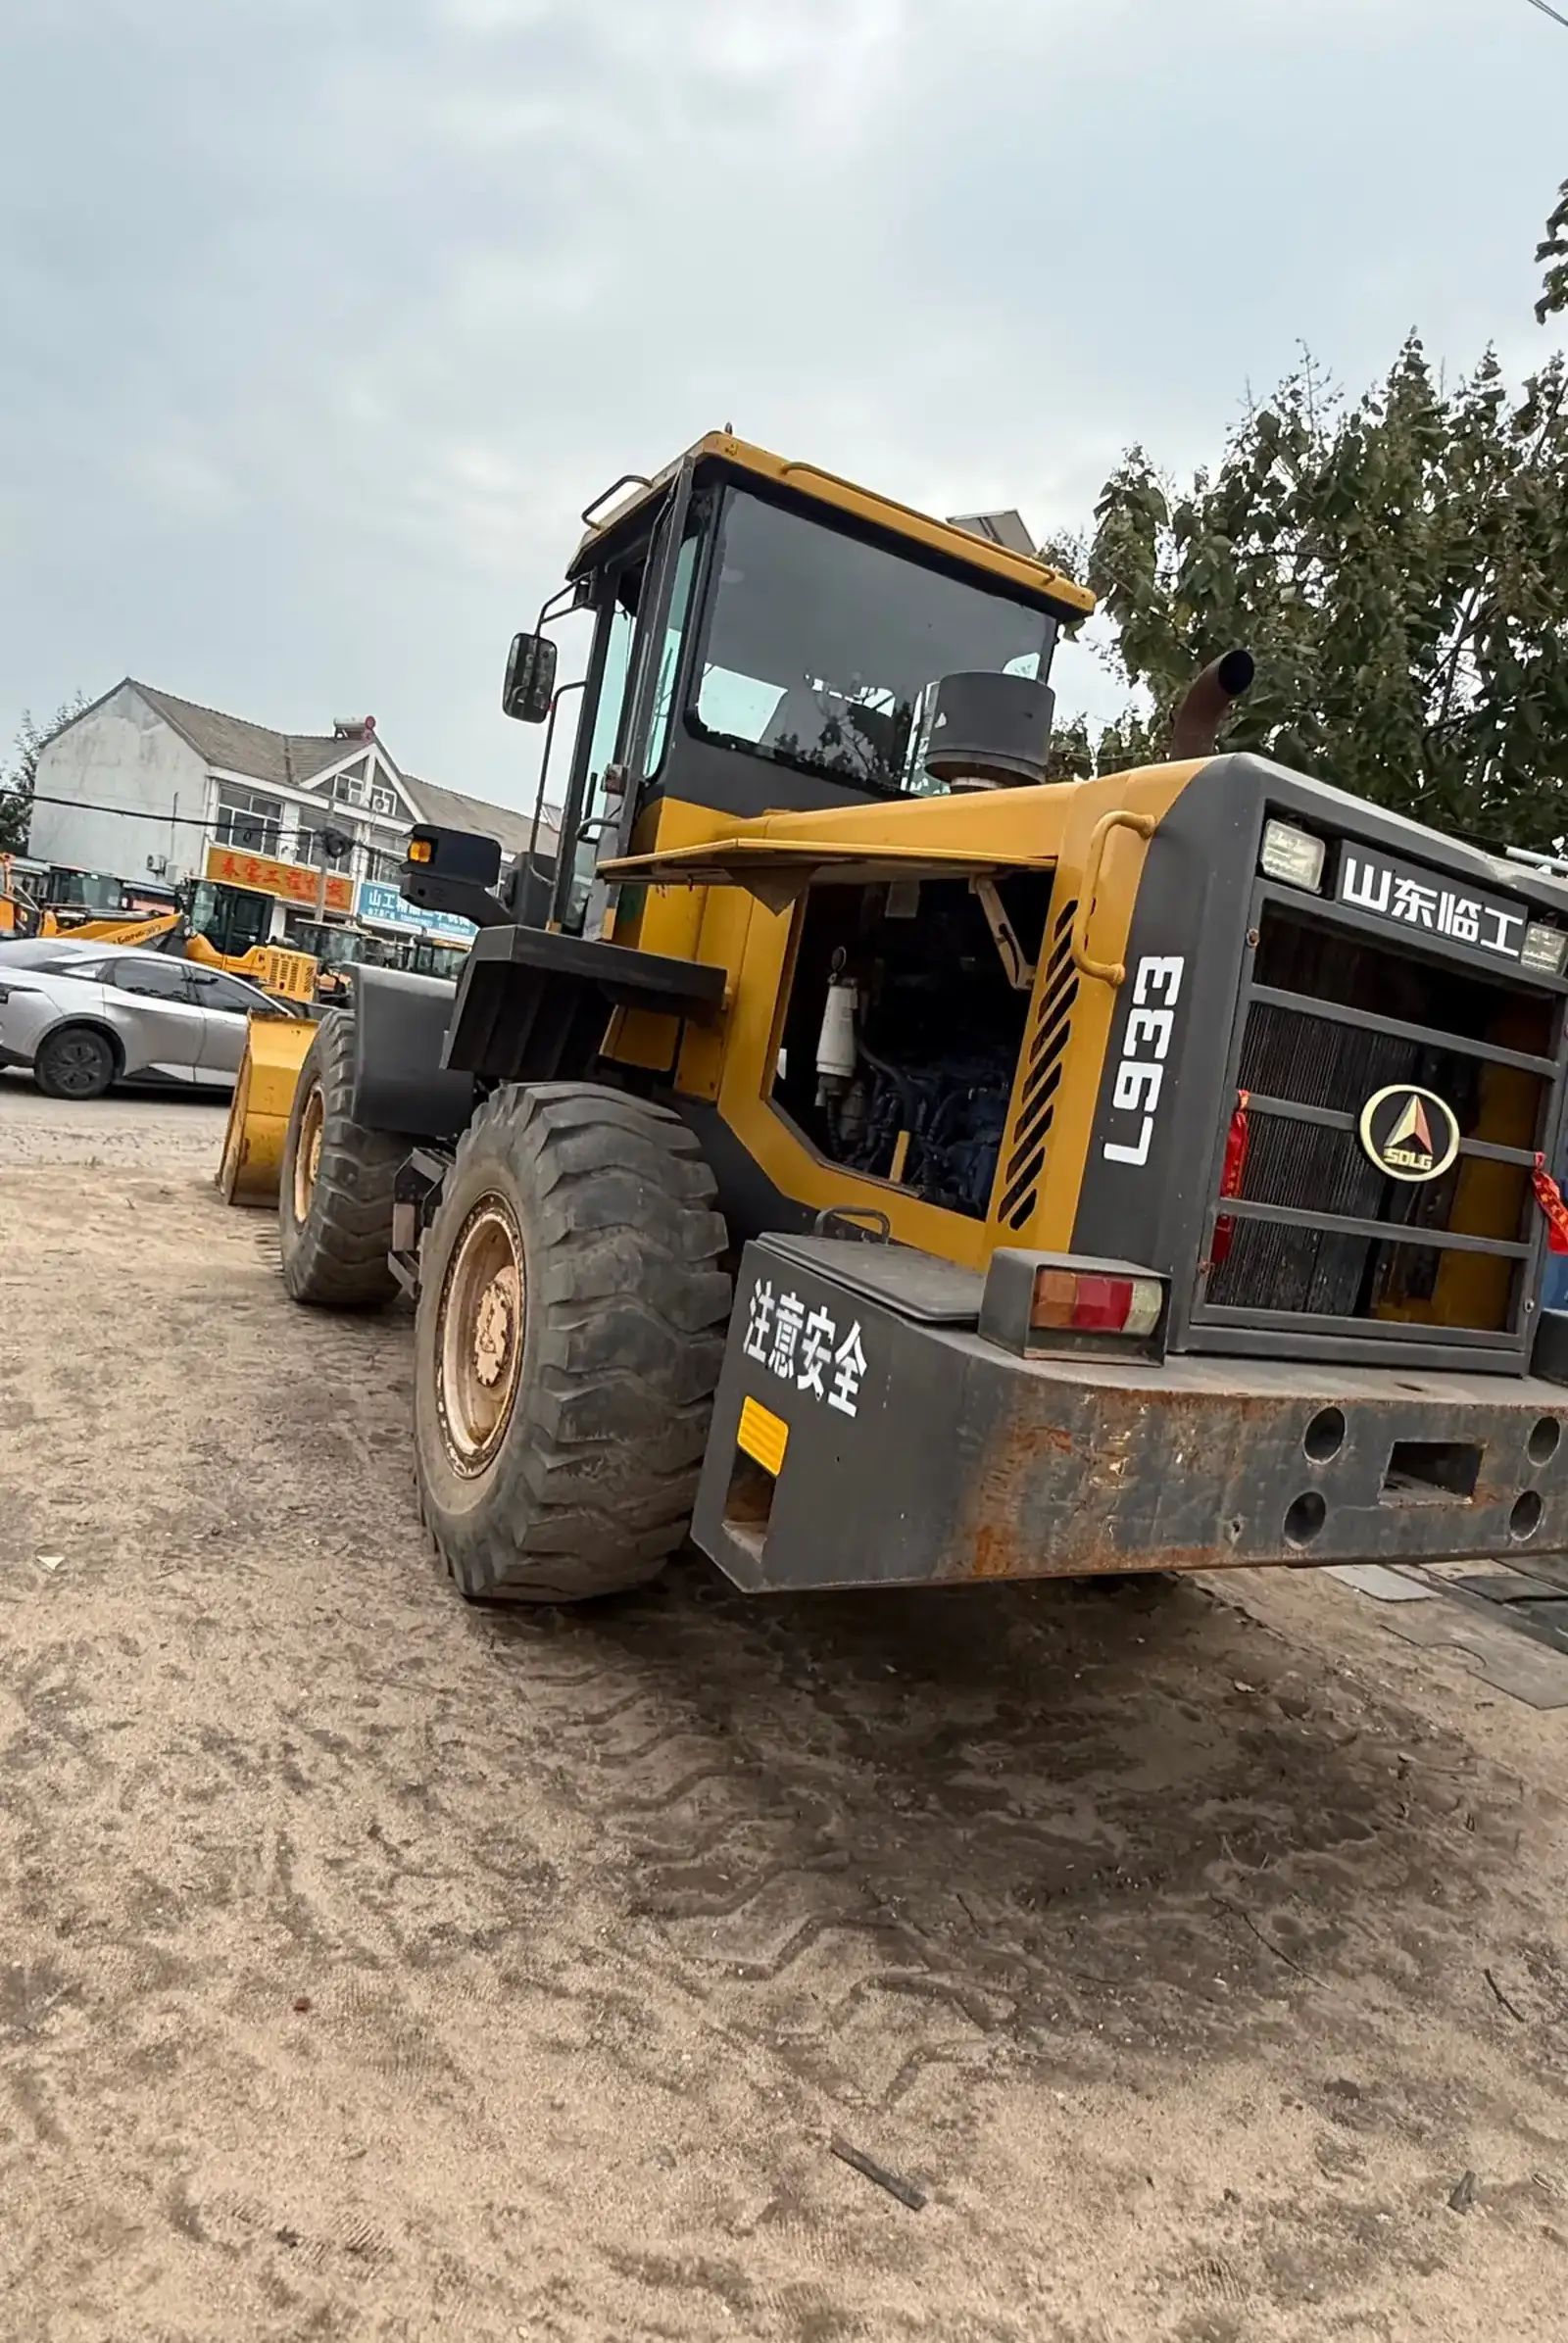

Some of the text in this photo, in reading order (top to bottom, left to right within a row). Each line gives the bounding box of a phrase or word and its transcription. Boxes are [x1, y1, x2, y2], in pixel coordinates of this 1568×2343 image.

[1343, 857, 1524, 957] 山东临工
[1103, 955, 1184, 1167] L933
[1383, 1147, 1433, 1172] SDLG
[743, 1277, 869, 1418] 注意安全
